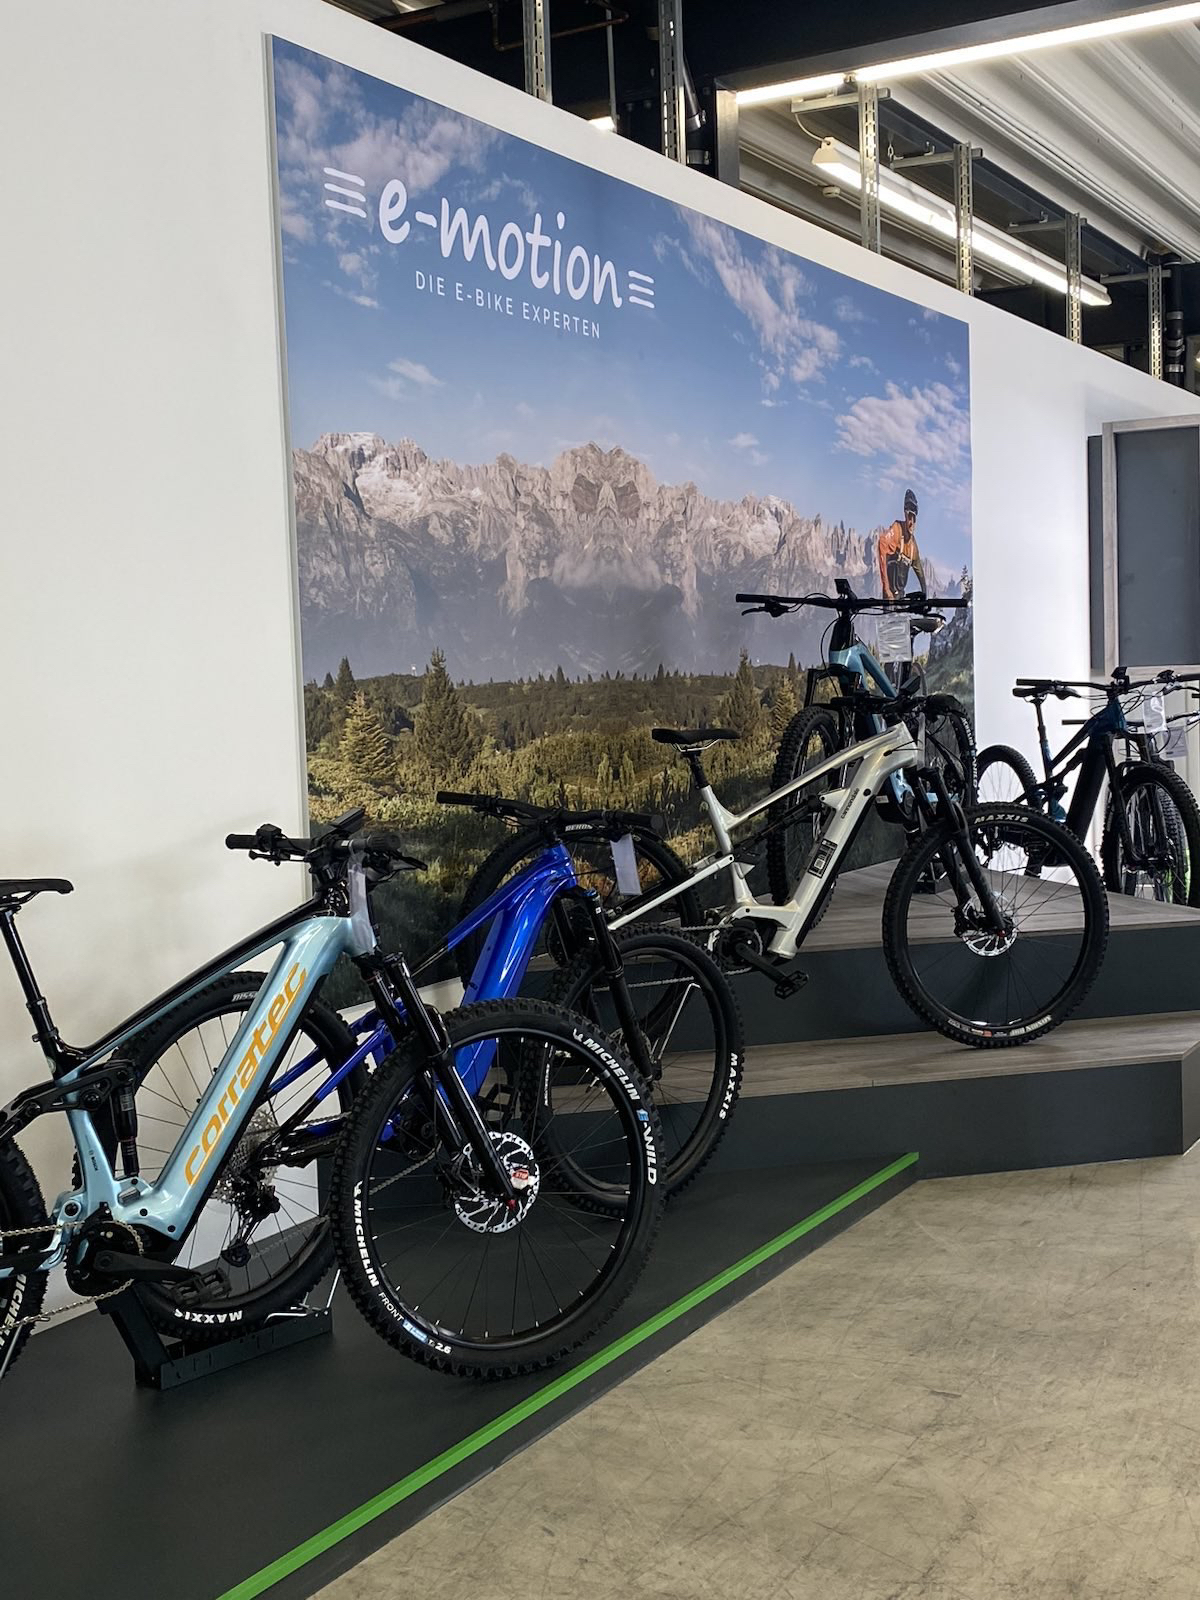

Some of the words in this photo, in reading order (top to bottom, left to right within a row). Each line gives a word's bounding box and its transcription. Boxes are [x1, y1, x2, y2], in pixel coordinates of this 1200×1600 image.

[378, 178, 623, 309] e-motion
[415, 270, 446, 296] DIE
[455, 282, 514, 316] E-BIKE
[522, 301, 601, 339] EXPERTEN
[974, 813, 1029, 825] MAXXIS
[184, 962, 308, 1187] corratec
[582, 1037, 641, 1100] MICHELIN
[719, 1052, 738, 1120] MAXXIS
[353, 1198, 380, 1288] MICHELIN
[378, 1291, 405, 1321] FRONT
[174, 1308, 243, 1324] MAXXIS
